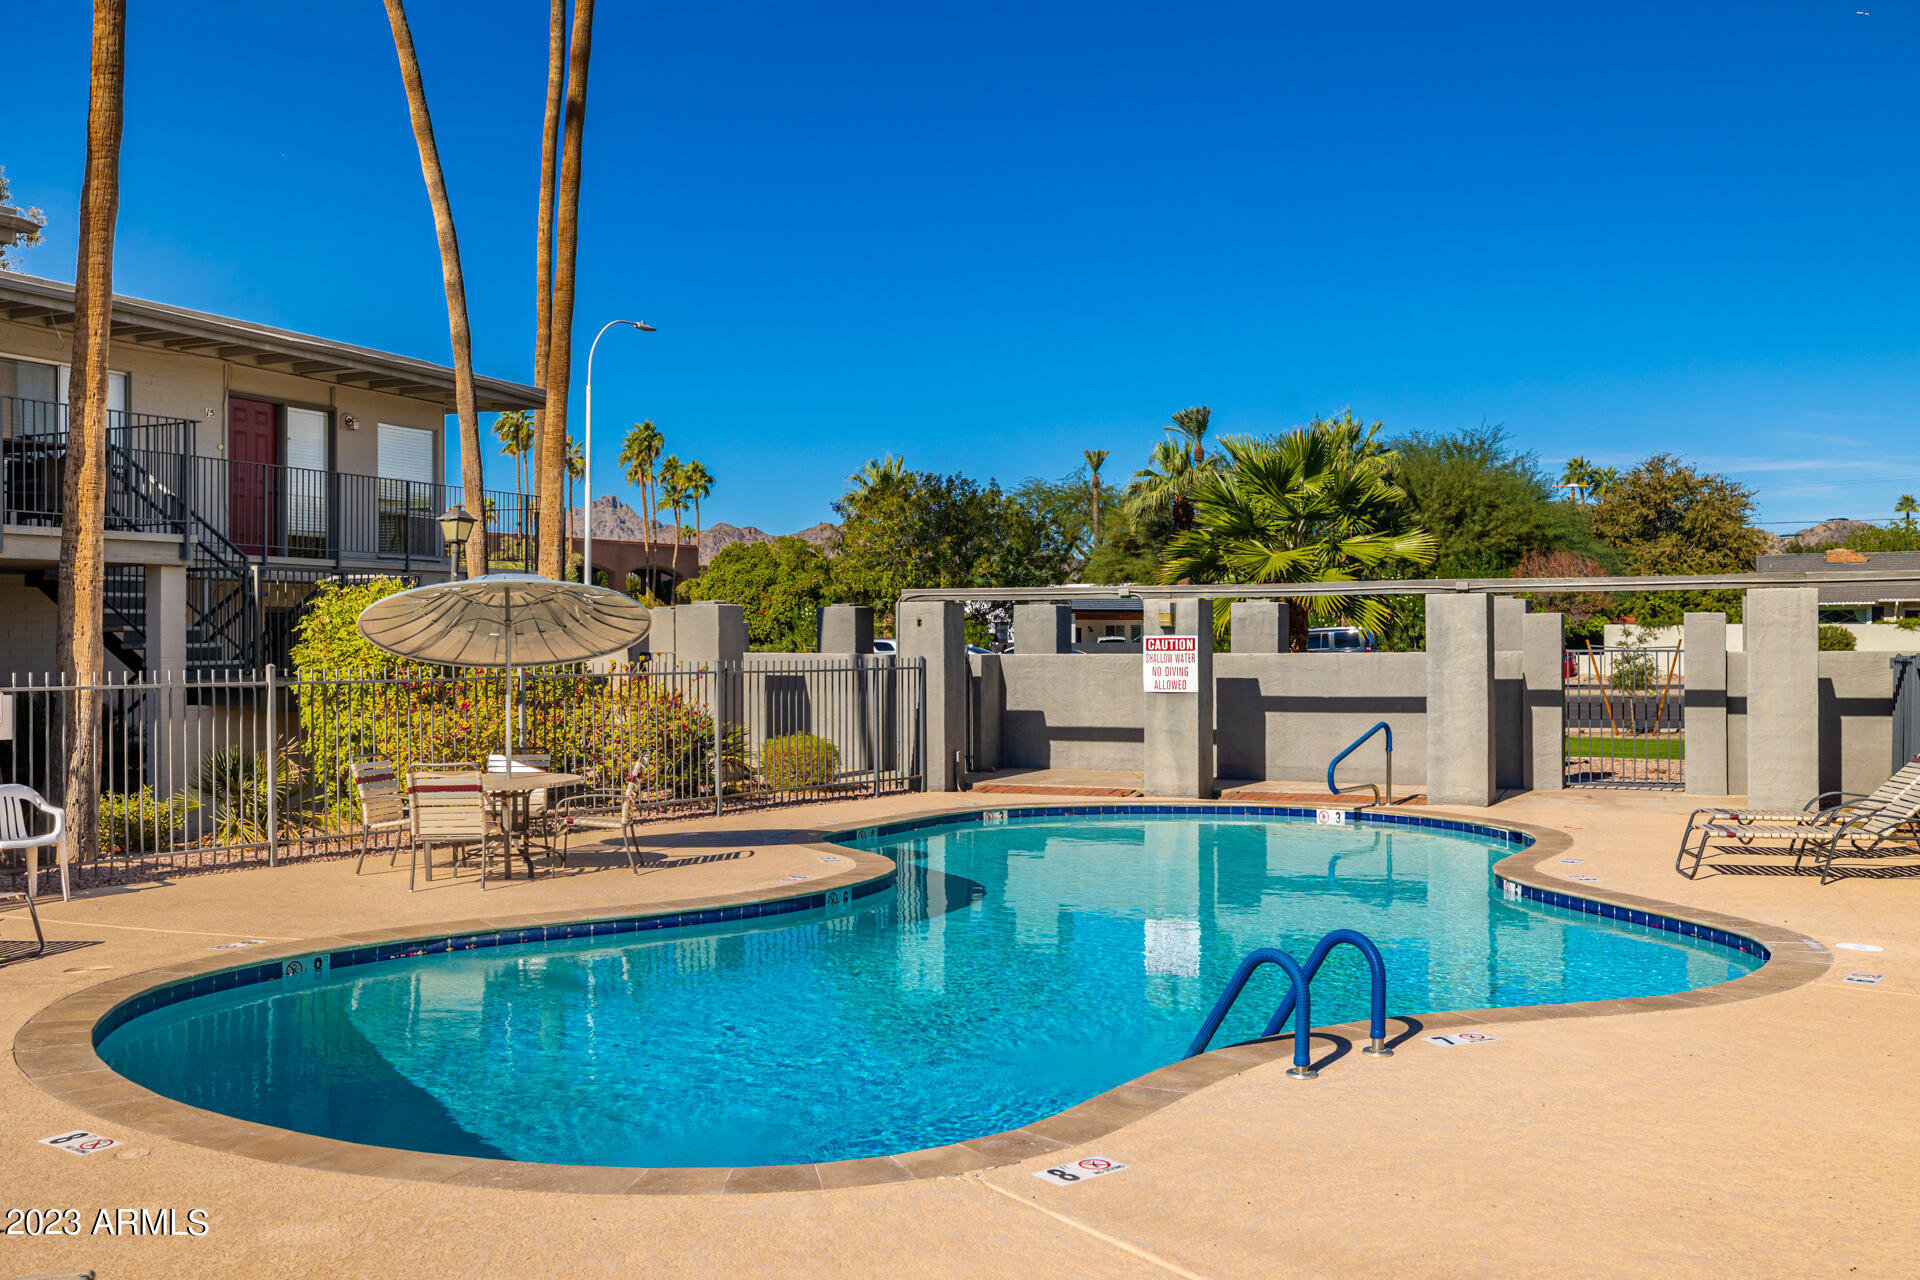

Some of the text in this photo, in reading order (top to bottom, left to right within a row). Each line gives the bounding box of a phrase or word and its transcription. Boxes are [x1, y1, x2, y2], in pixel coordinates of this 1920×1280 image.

[1147, 639, 1194, 650] CAUTION
[1146, 653, 1196, 663] SHALLOW WATER
[1152, 666, 1189, 677] NO DIVING
[1154, 680, 1187, 690] ALLOWED
[1335, 811, 1341, 824] 3
[49, 1132, 89, 1144] 8
[1046, 1168, 1081, 1181] 8
